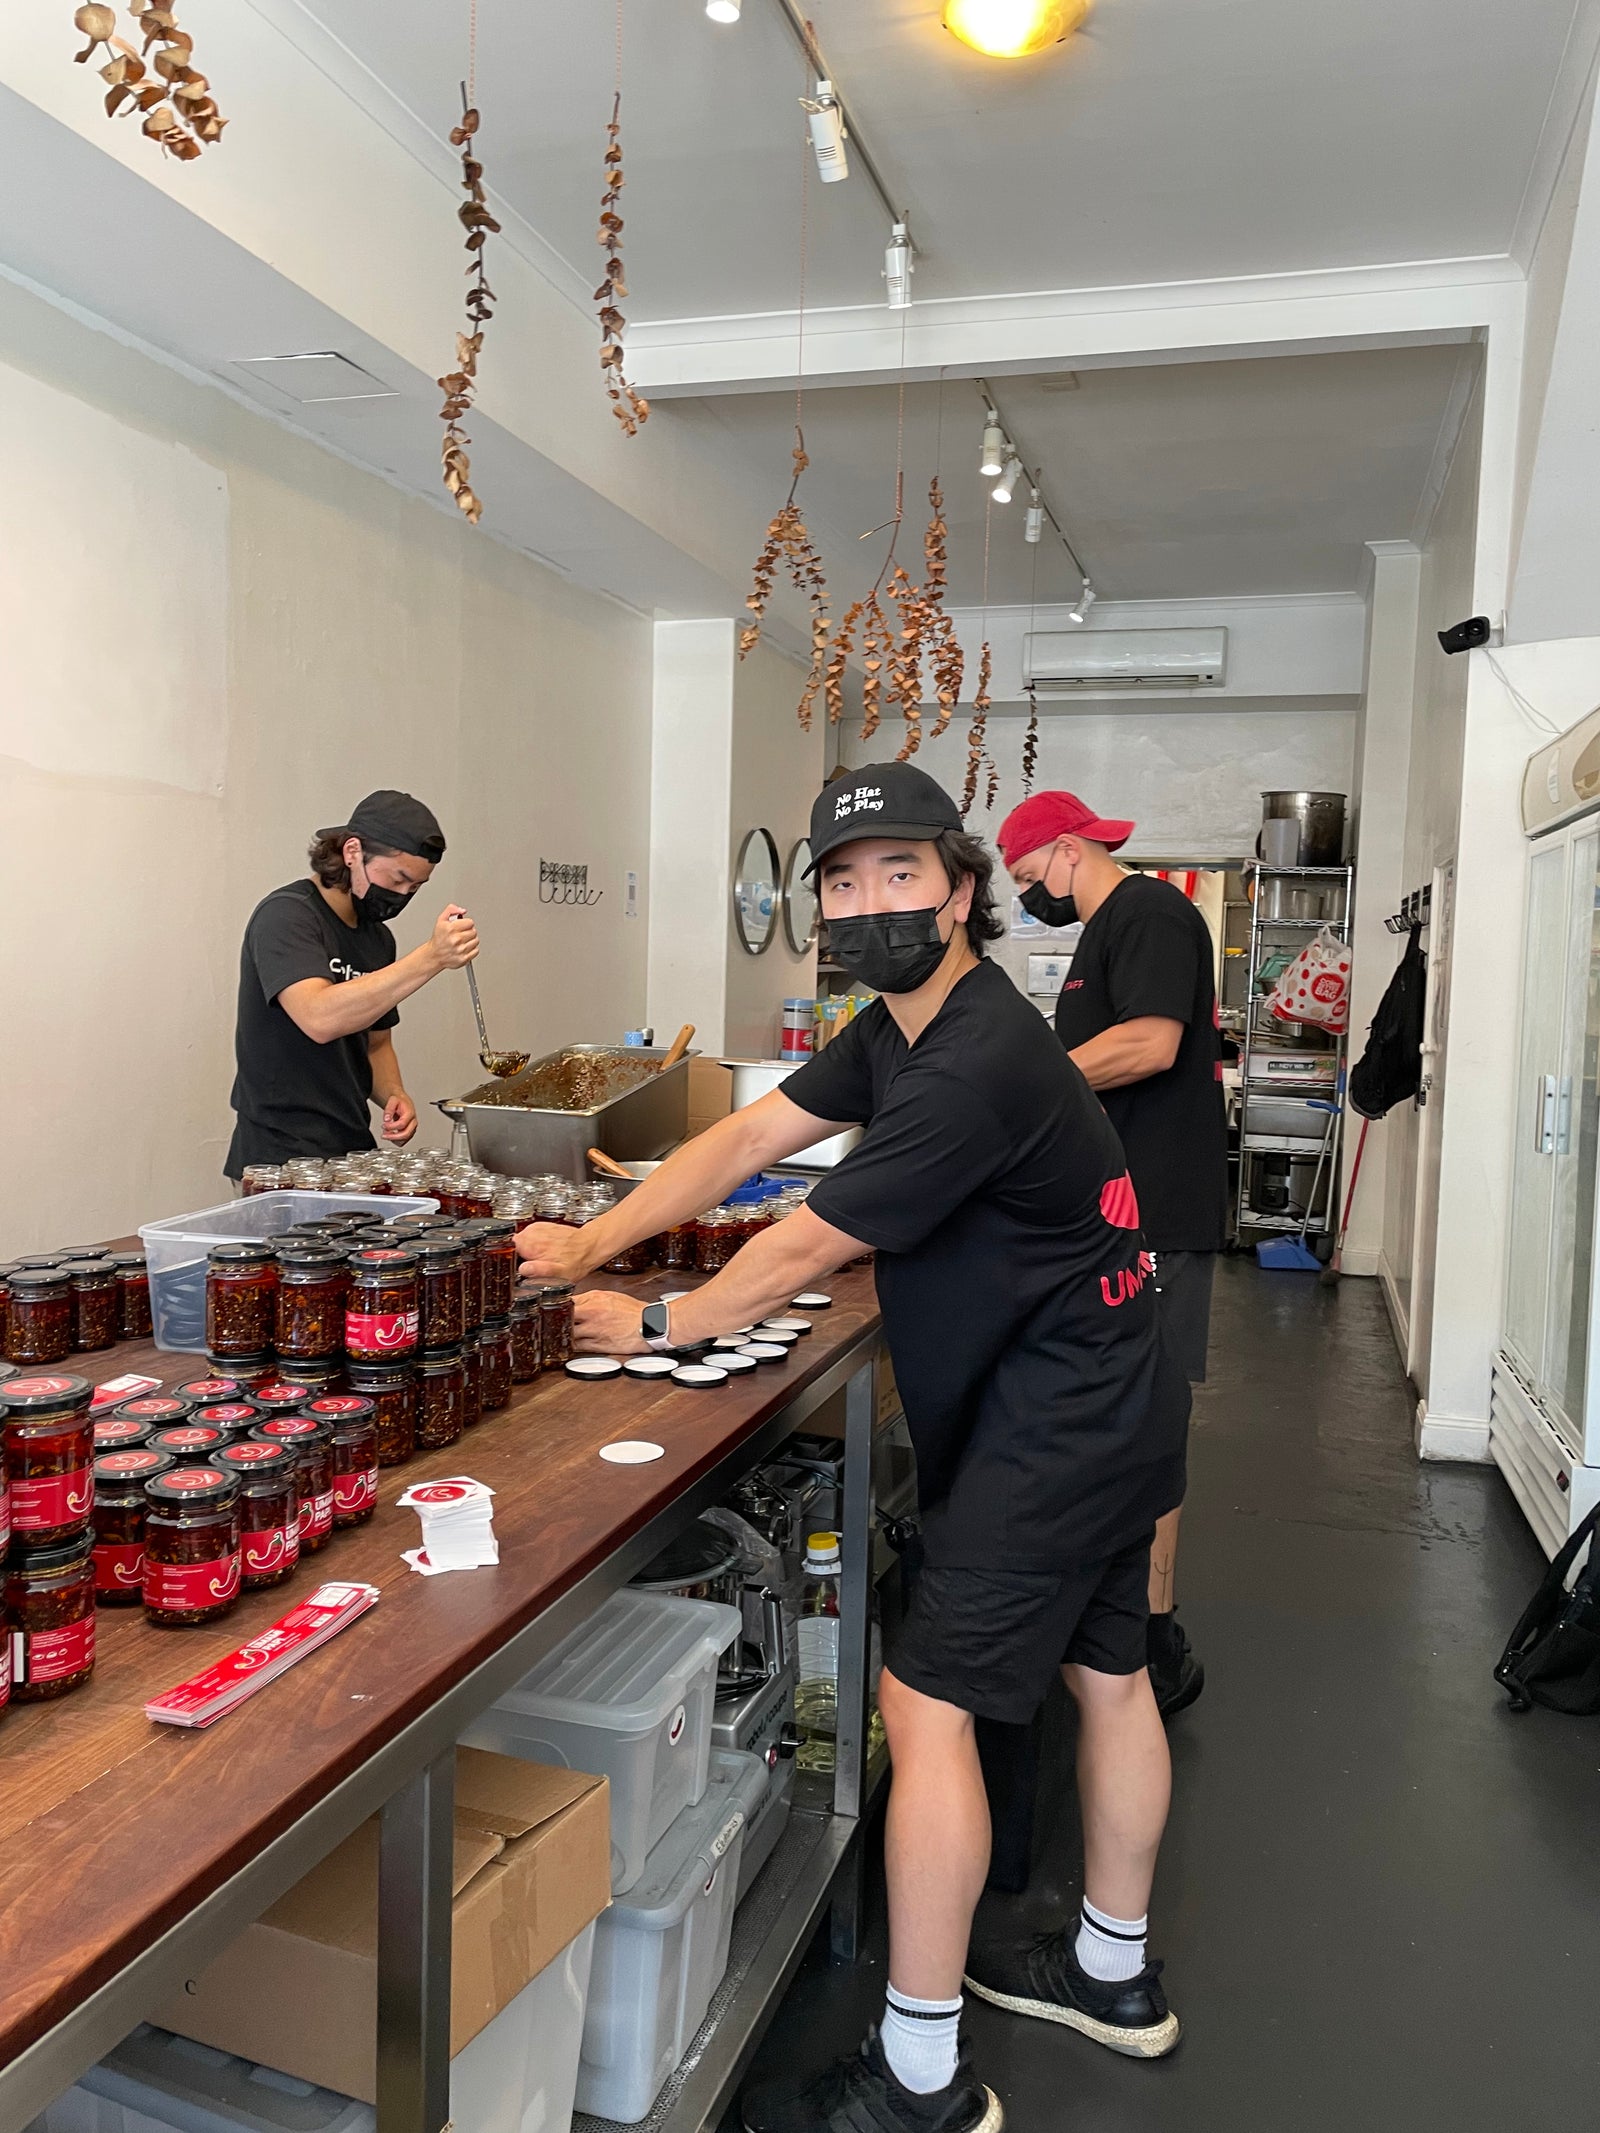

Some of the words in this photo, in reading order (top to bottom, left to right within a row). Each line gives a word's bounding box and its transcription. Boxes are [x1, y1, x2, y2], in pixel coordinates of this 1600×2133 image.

[836, 794, 852, 808] No
[854, 786, 881, 799] Hat
[834, 806, 851, 821] No
[853, 798, 883, 812] Play
